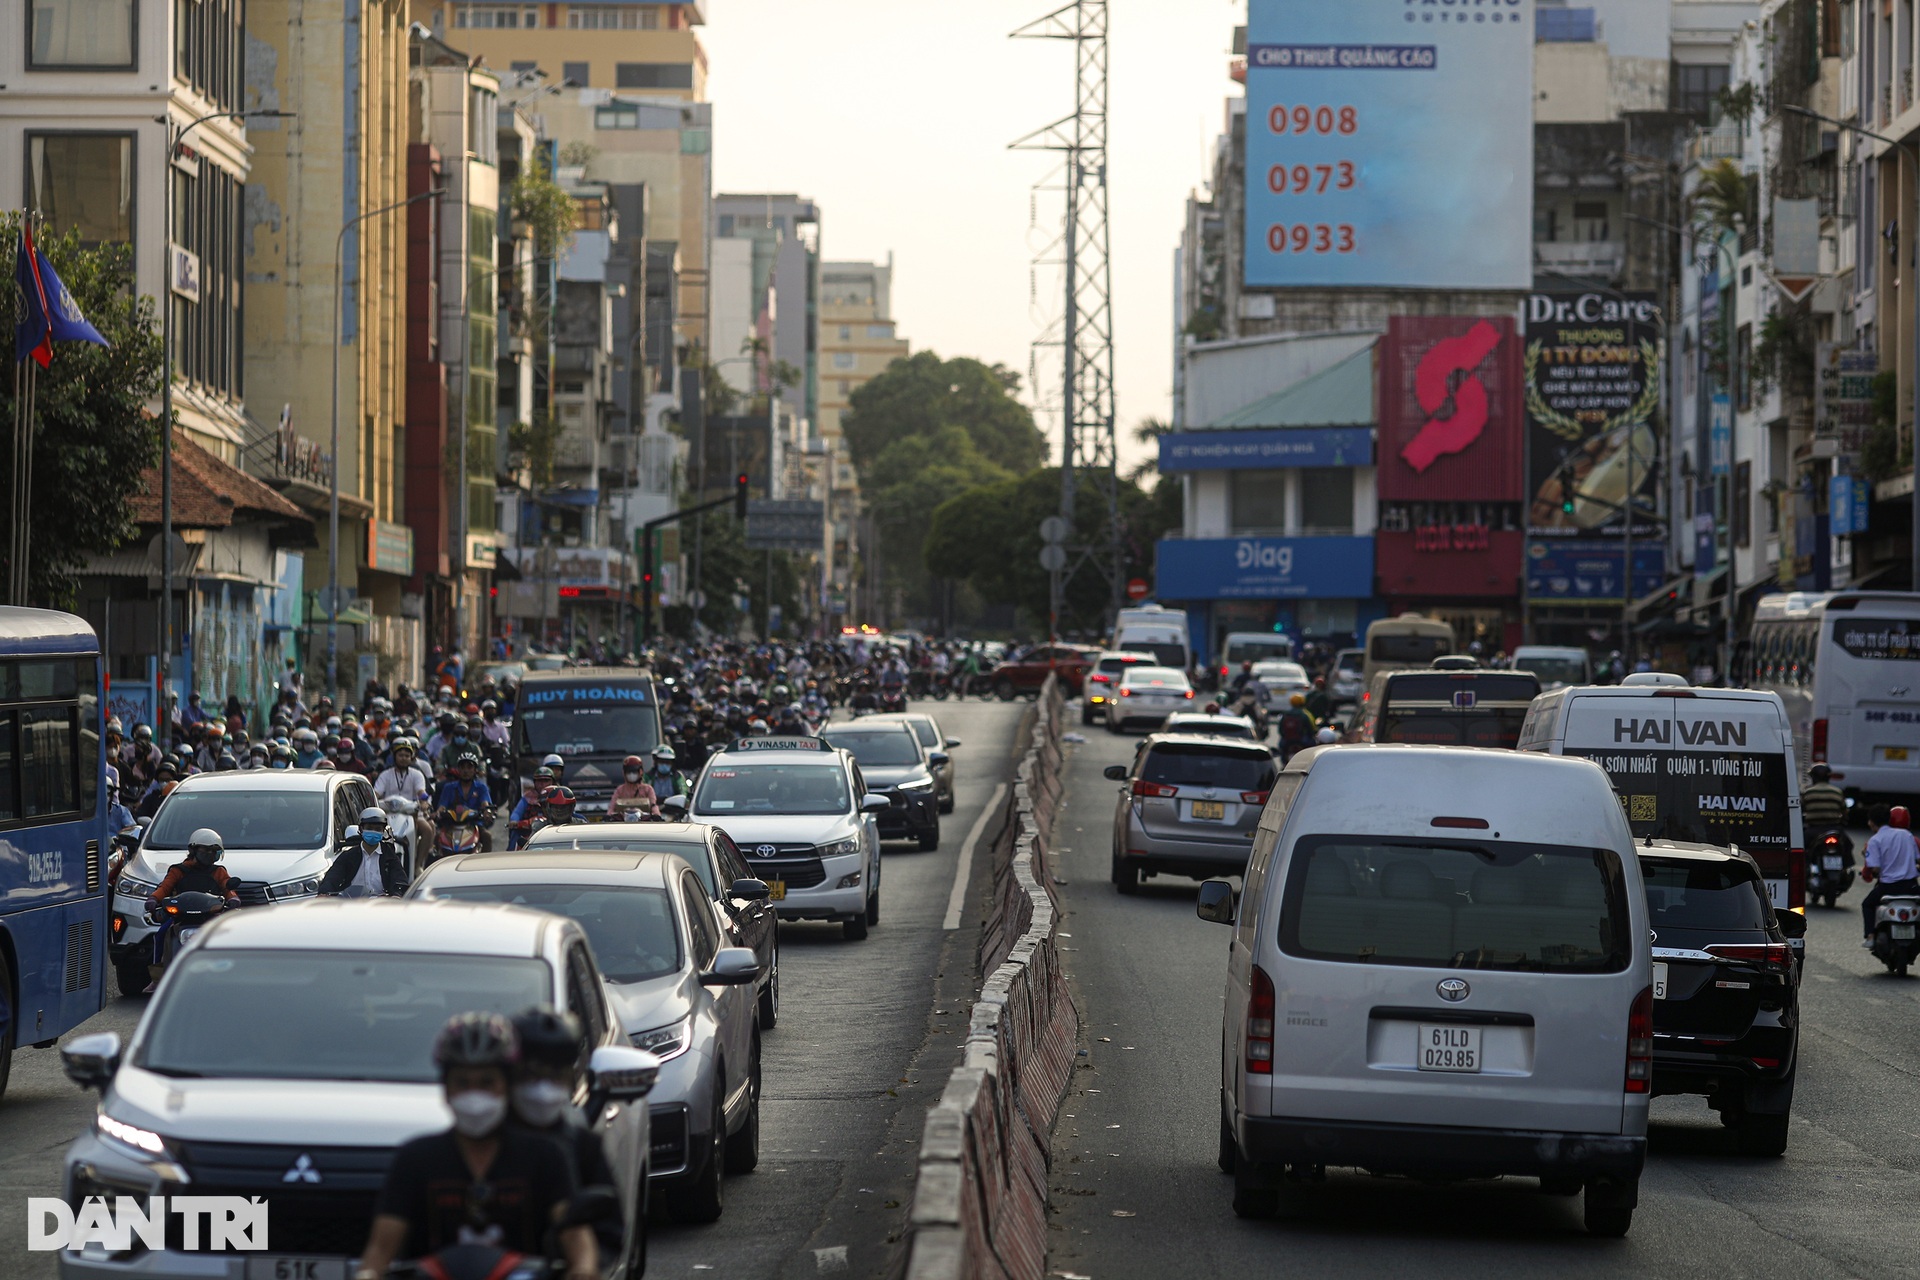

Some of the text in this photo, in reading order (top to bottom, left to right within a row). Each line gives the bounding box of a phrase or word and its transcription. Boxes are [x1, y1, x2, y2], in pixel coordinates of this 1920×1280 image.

[1403, 11, 1521, 23] OUTDOOR
[1257, 47, 1291, 66] CHO
[1294, 45, 1337, 66] THUÊ
[1400, 45, 1434, 67] CÁO
[1268, 104, 1358, 136] 0908
[1267, 159, 1356, 195] 0973
[1267, 222, 1356, 255] 0933
[1529, 293, 1653, 323] Dr.Care
[528, 686, 645, 704] HUY HOÀNG
[1614, 718, 1746, 746] HAI VAN
[757, 741, 817, 749] VINASUN TAXI
[1606, 755, 1627, 773] SƠN
[1630, 753, 1657, 774] NHẤT
[1667, 757, 1696, 777] QUẬN
[1712, 758, 1740, 775] VŨNG
[1742, 759, 1762, 777] TÀU
[1698, 795, 1766, 811] HAI VAN
[1718, 811, 1763, 819] TRANSPORTATION
[1750, 835, 1759, 843] XE
[1286, 1017, 1328, 1027] HIACE
[1432, 1028, 1469, 1048] 61LD
[1425, 1049, 1475, 1068] 029.85
[275, 1258, 318, 1280] 61K
